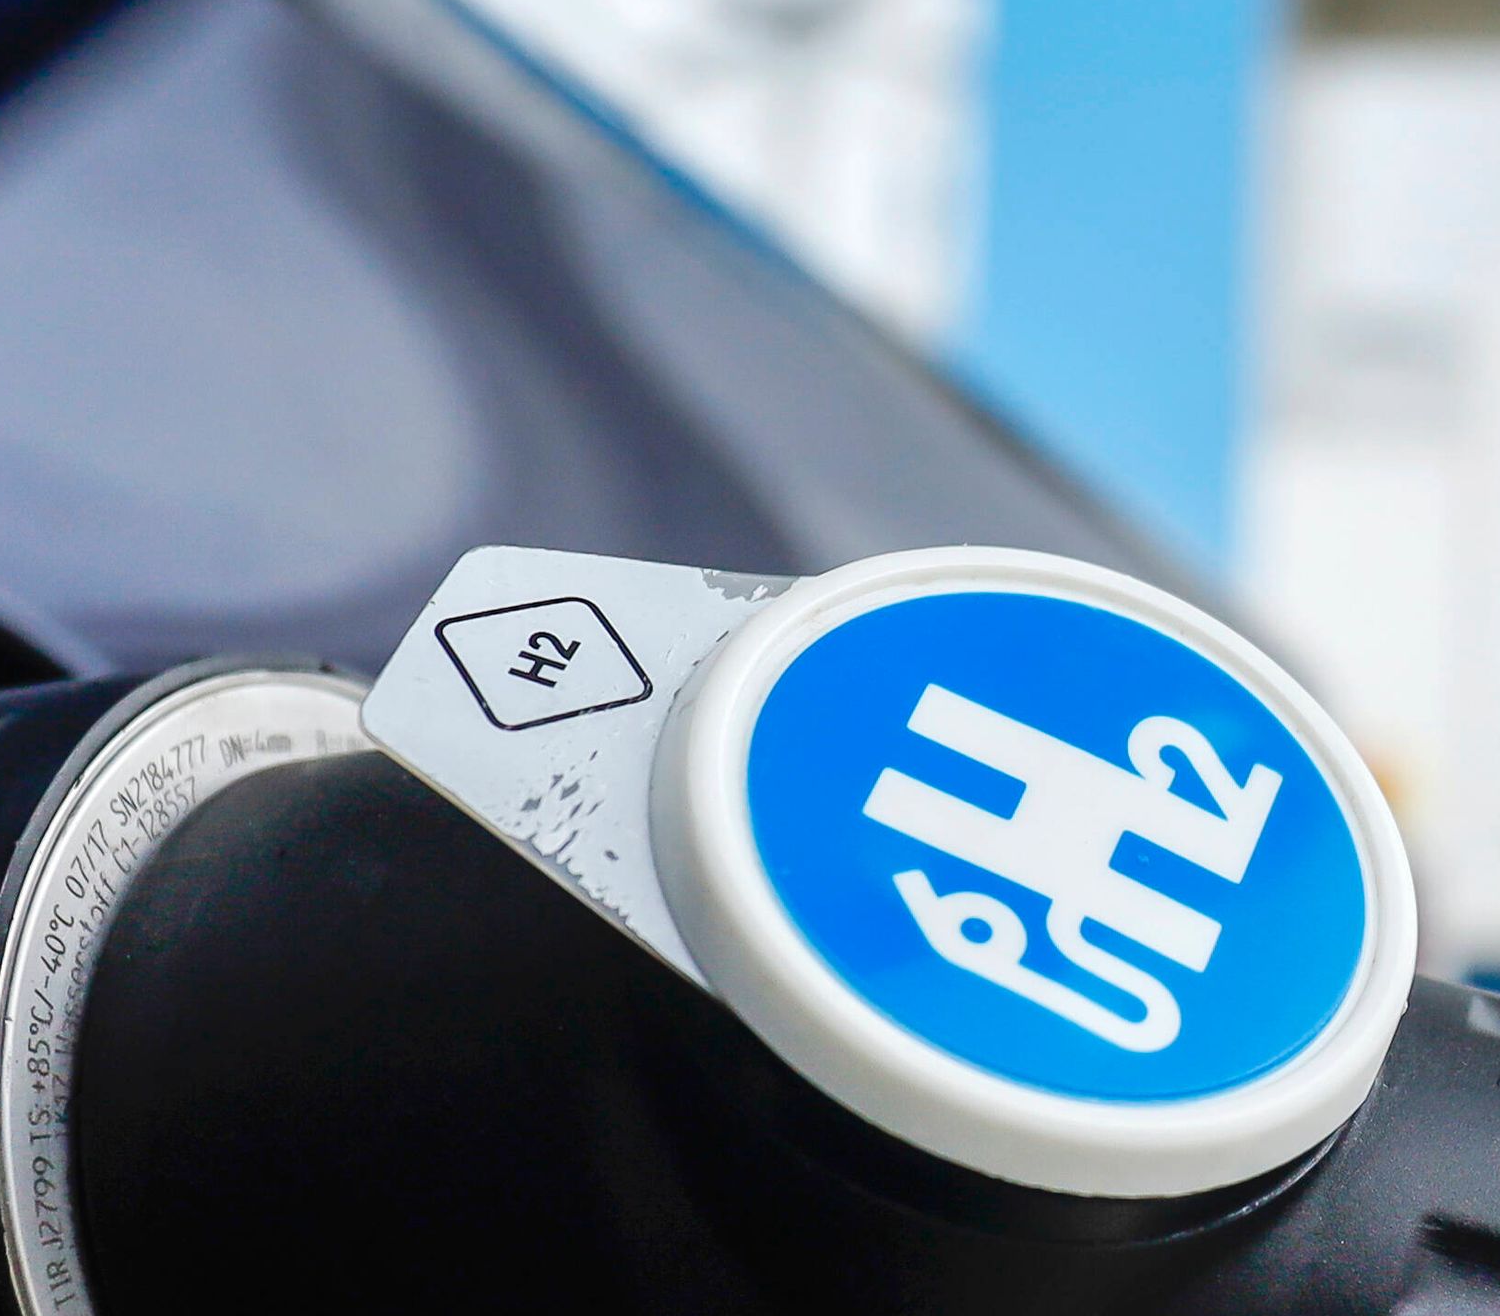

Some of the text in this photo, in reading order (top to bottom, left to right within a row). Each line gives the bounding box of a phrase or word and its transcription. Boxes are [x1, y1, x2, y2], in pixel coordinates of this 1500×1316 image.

[506, 627, 583, 689] H2
[110, 734, 205, 827] SN2184777
[65, 819, 109, 899] 07/17
[112, 776, 197, 874] C1-128557
[861, 682, 1283, 974] H2
[28, 1103, 52, 1145] TS:
[32, 1156, 65, 1251] J2799
[46, 1257, 76, 1311] TIR
